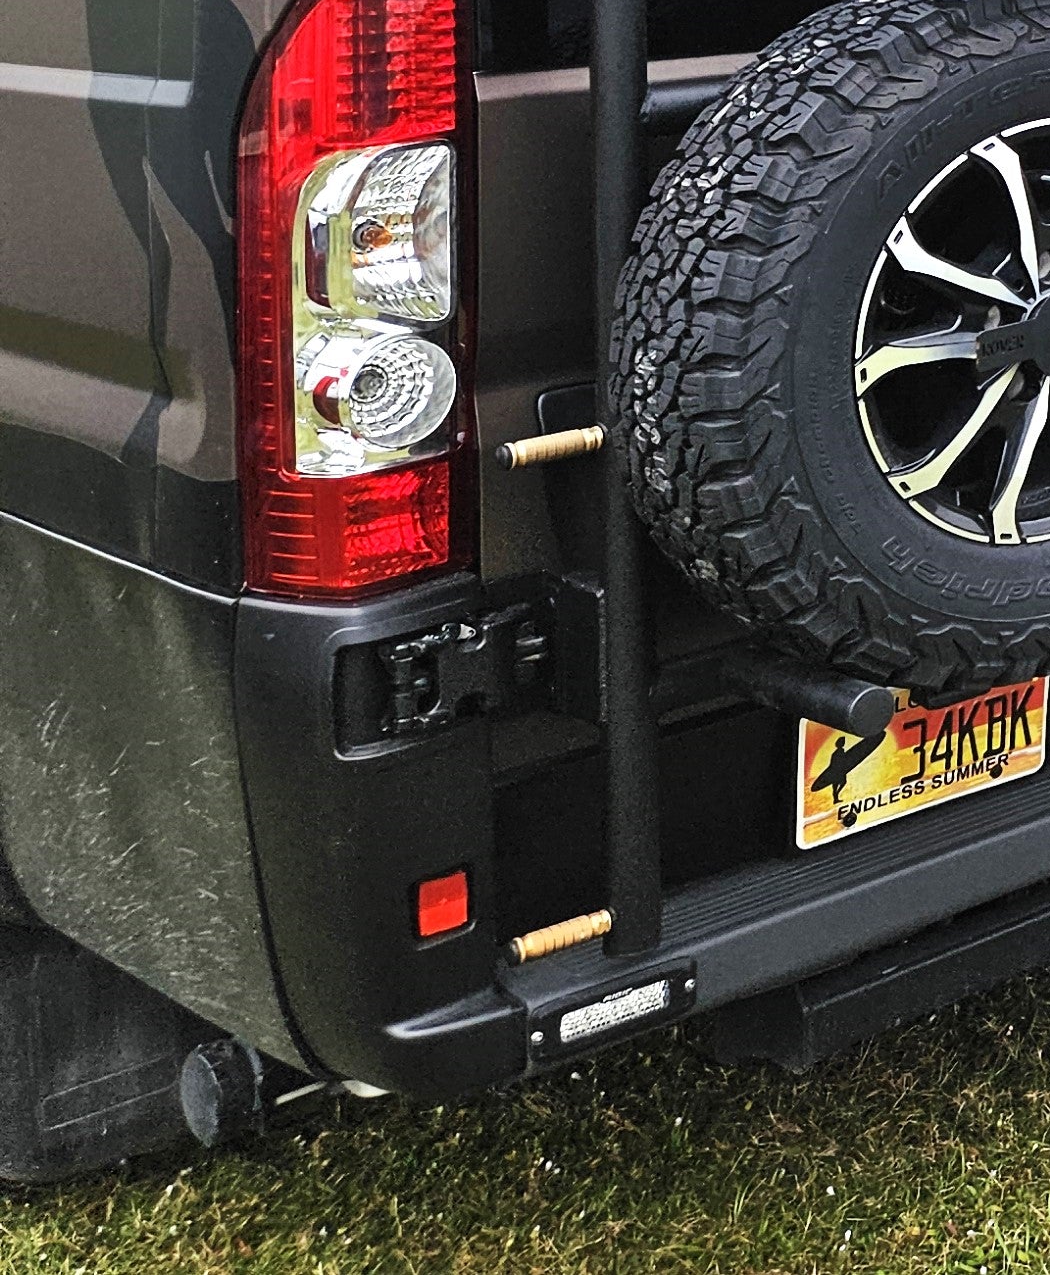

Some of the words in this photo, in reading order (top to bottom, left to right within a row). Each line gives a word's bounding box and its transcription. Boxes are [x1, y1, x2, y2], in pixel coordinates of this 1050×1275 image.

[901, 685, 1035, 786] 34KBK
[837, 779, 926, 821] ENDLESS
[931, 753, 1010, 790] SUMMER
